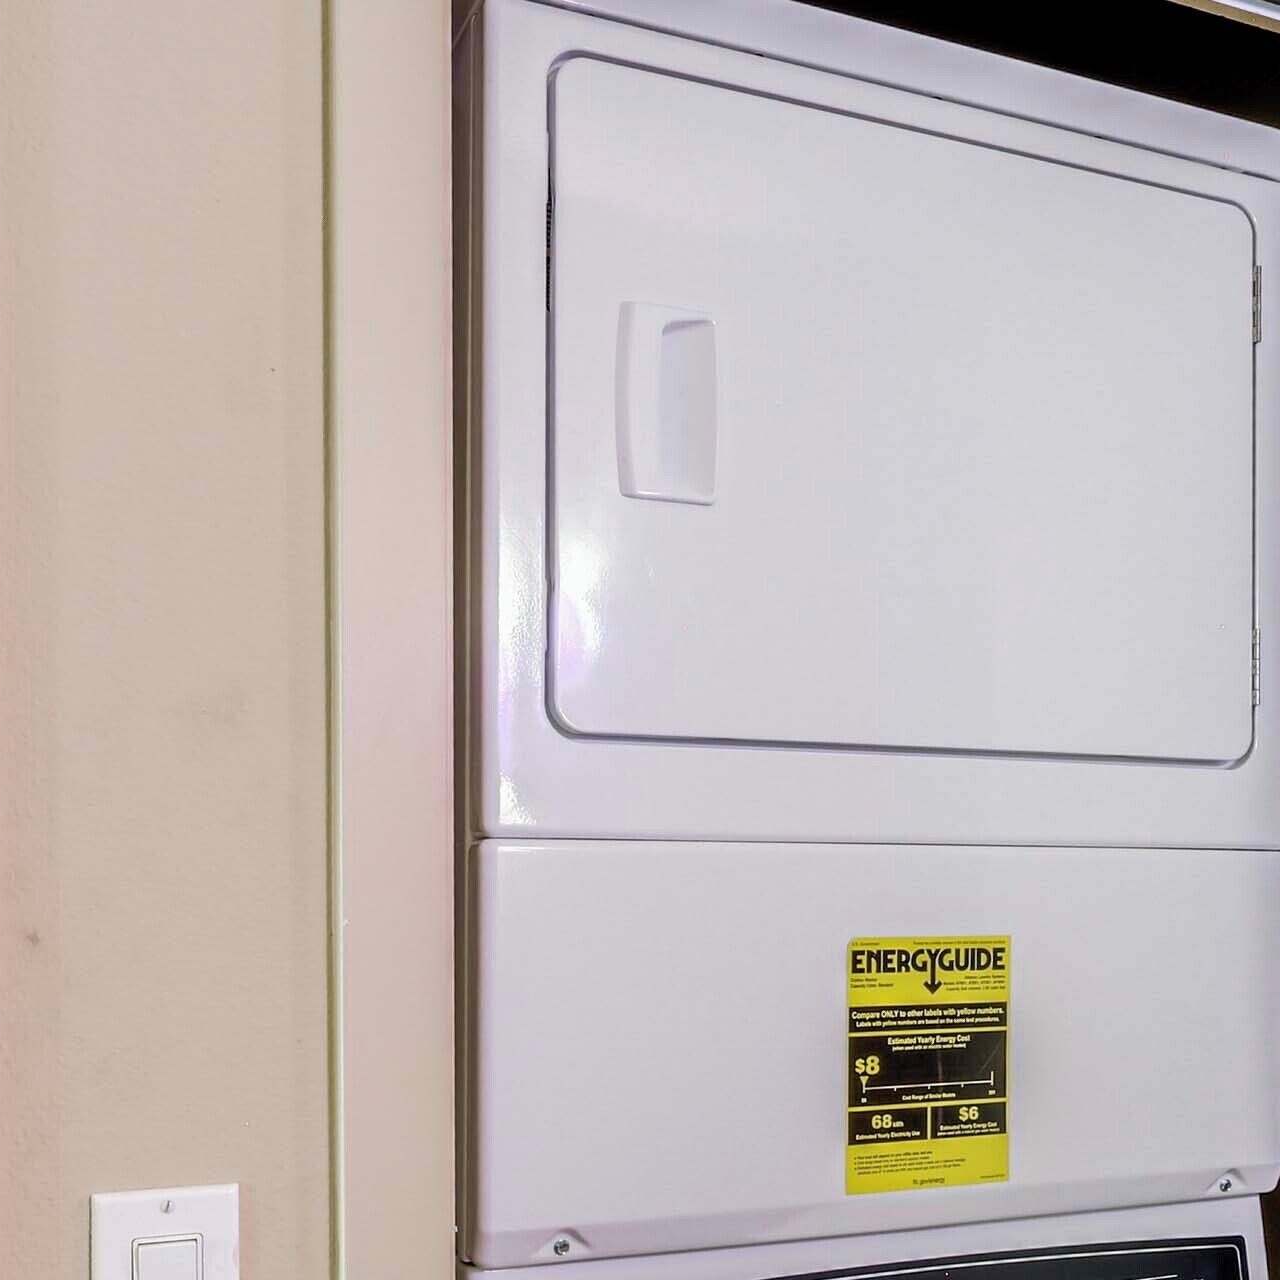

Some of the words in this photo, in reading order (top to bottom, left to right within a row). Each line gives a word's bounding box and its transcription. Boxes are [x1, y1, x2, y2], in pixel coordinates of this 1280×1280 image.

[851, 947, 1006, 974] ENERGYGUIDE
[851, 1011, 880, 1020] Compare
[881, 1010, 899, 1018] ONLY
[907, 1009, 924, 1017] other
[943, 1008, 956, 1016] with
[957, 1007, 976, 1017] yellow
[887, 1036, 916, 1045] Estimated
[917, 1036, 935, 1045] Yearly
[936, 1035, 956, 1044] Energy
[957, 1034, 971, 1042] Cost
[854, 1055, 880, 1075] $8
[871, 1114, 892, 1129] 68
[959, 1106, 979, 1122] $6
